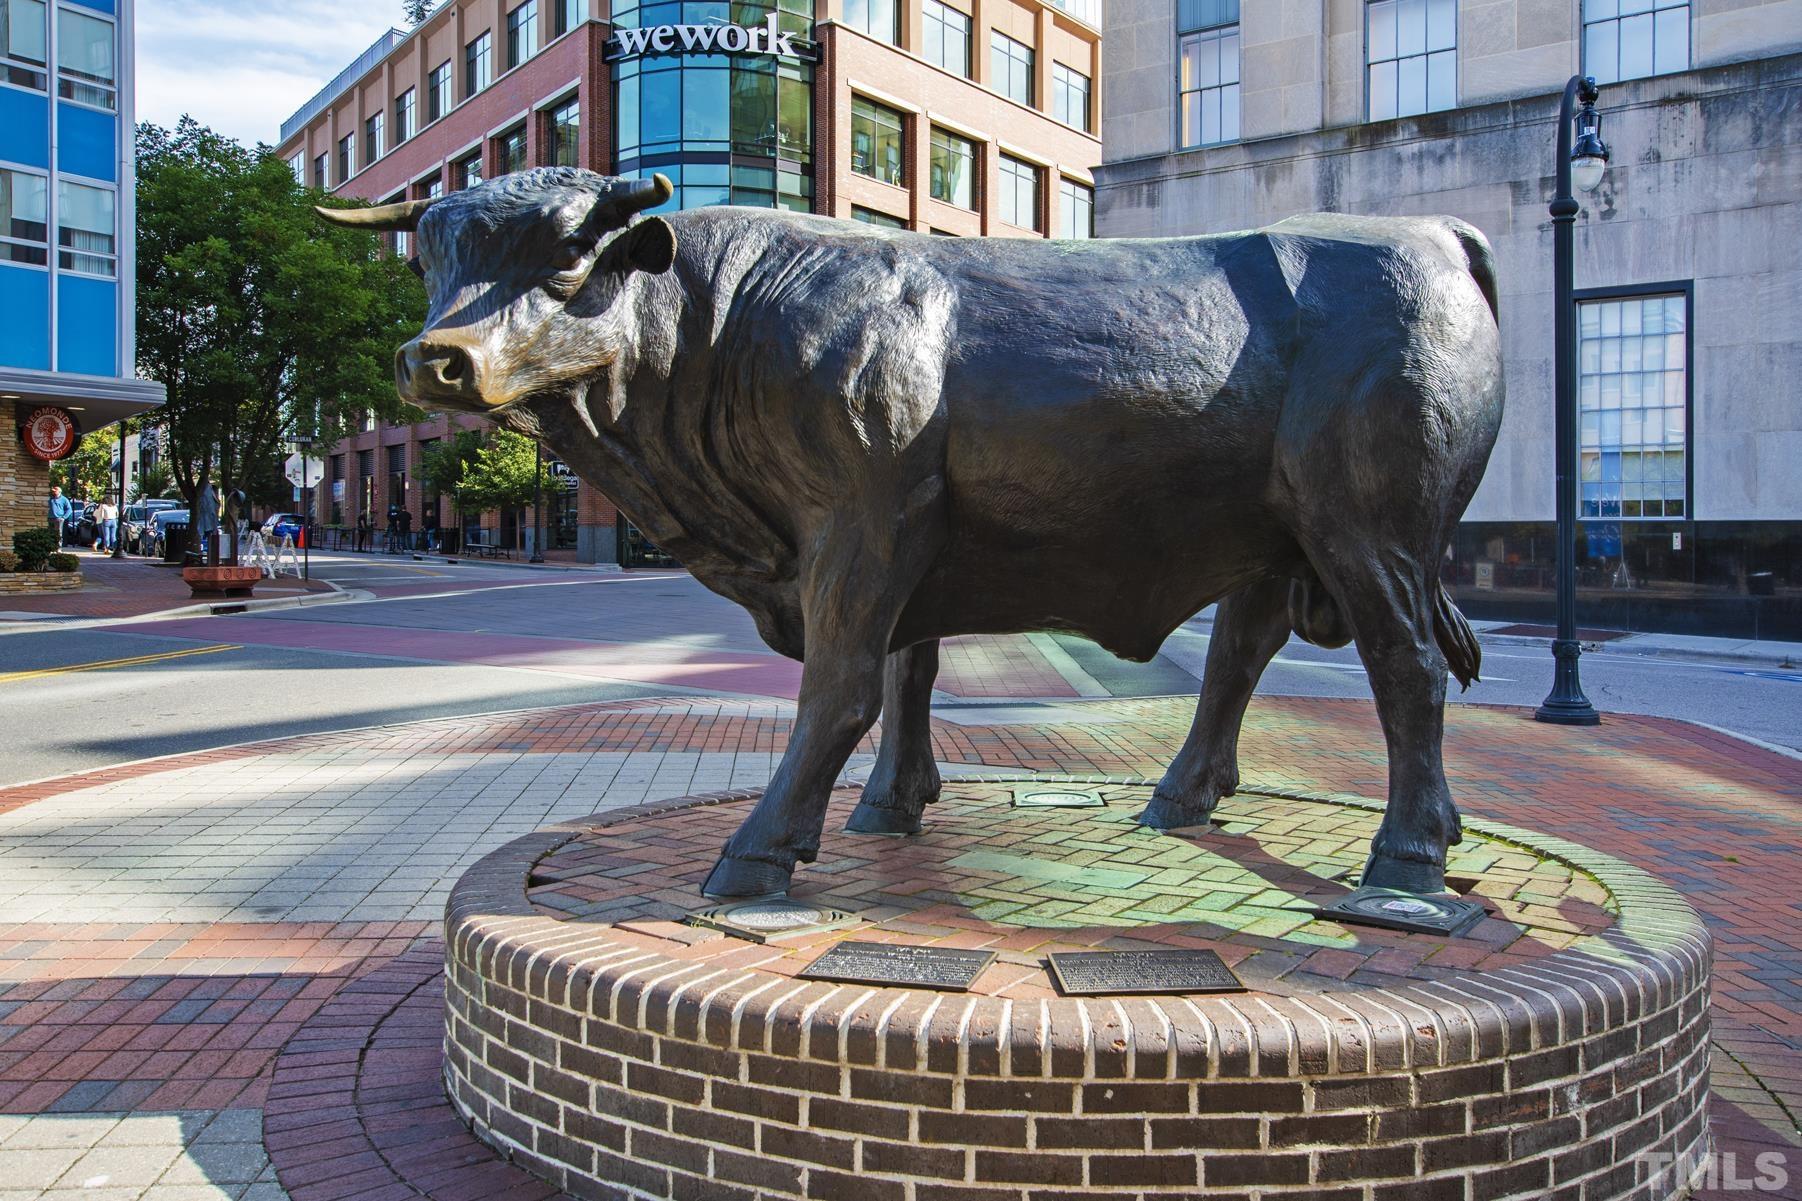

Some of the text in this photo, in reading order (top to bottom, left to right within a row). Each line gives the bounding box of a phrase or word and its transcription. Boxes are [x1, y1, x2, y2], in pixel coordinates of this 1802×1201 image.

[614, 13, 799, 56] wework
[25, 407, 72, 430] NEOMONDE
[34, 448, 50, 458] SINCE
